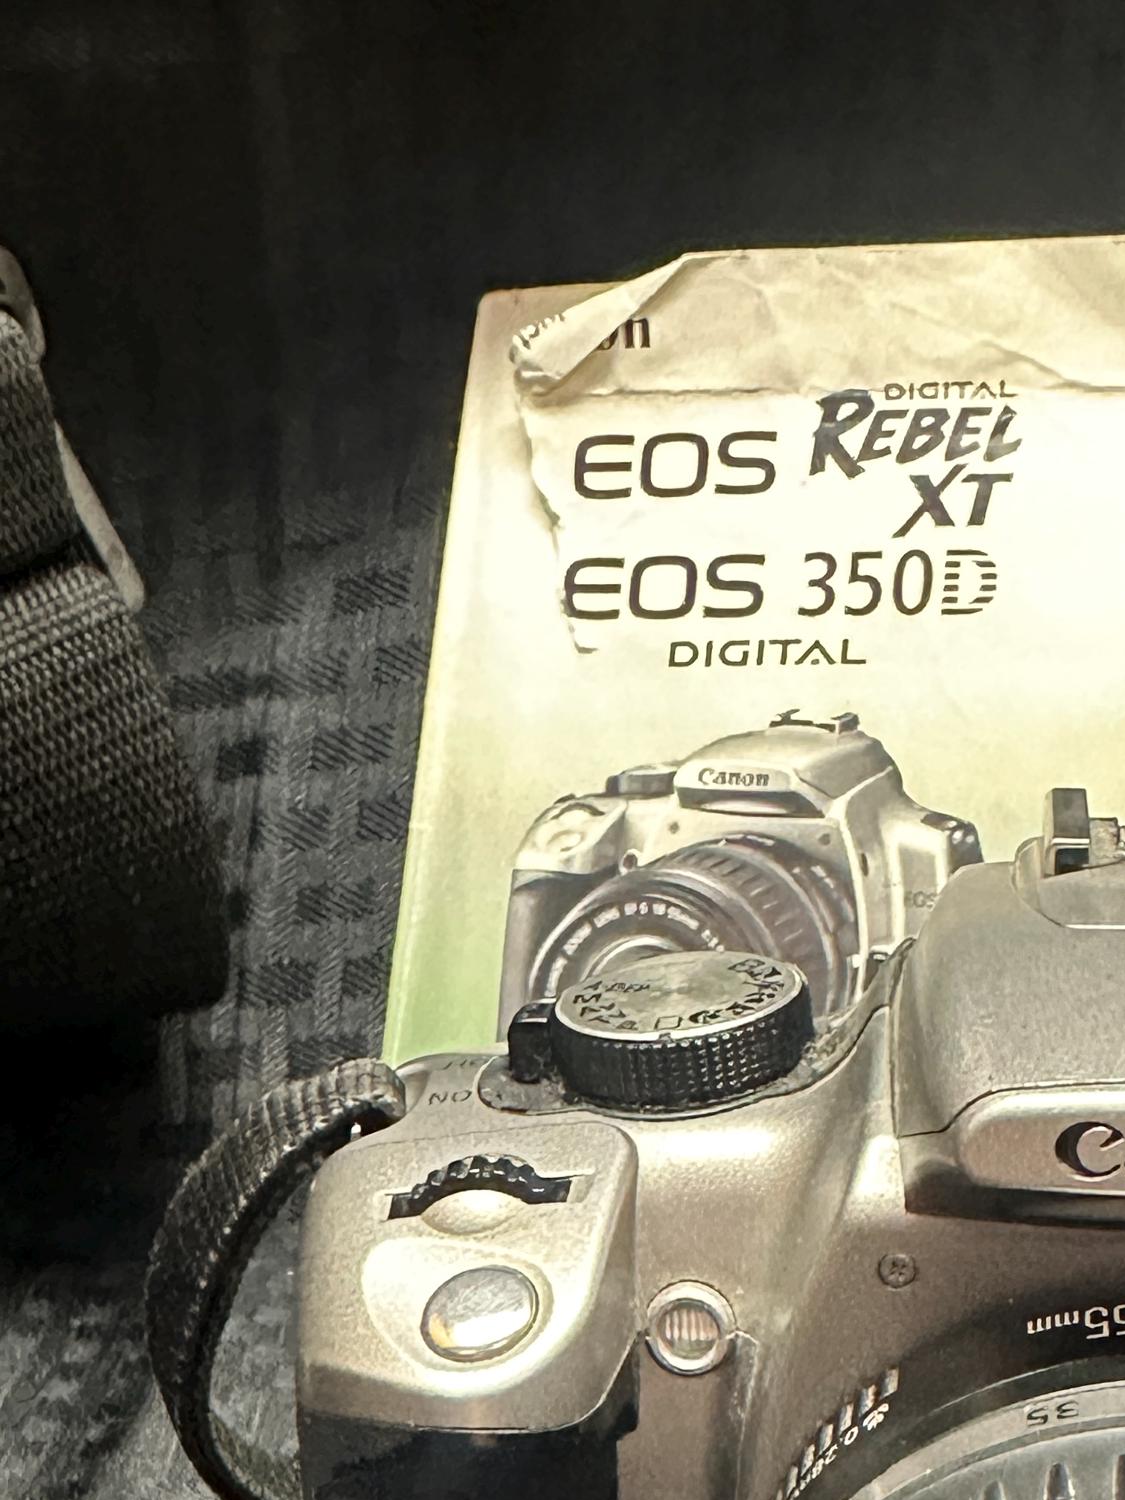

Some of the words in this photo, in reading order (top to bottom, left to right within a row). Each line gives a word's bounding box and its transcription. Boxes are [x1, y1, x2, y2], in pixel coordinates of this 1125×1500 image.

[884, 380, 1019, 400] DIGITAL
[574, 430, 778, 500] EOS
[809, 388, 1023, 480] REBEL
[891, 463, 1014, 538] XT
[564, 554, 766, 620] EOS
[798, 549, 998, 616] 350D
[668, 639, 867, 667] DIGITAL
[697, 767, 770, 787] Canon
[428, 1089, 472, 1105] ON
[1026, 1400, 1080, 1427] 35
